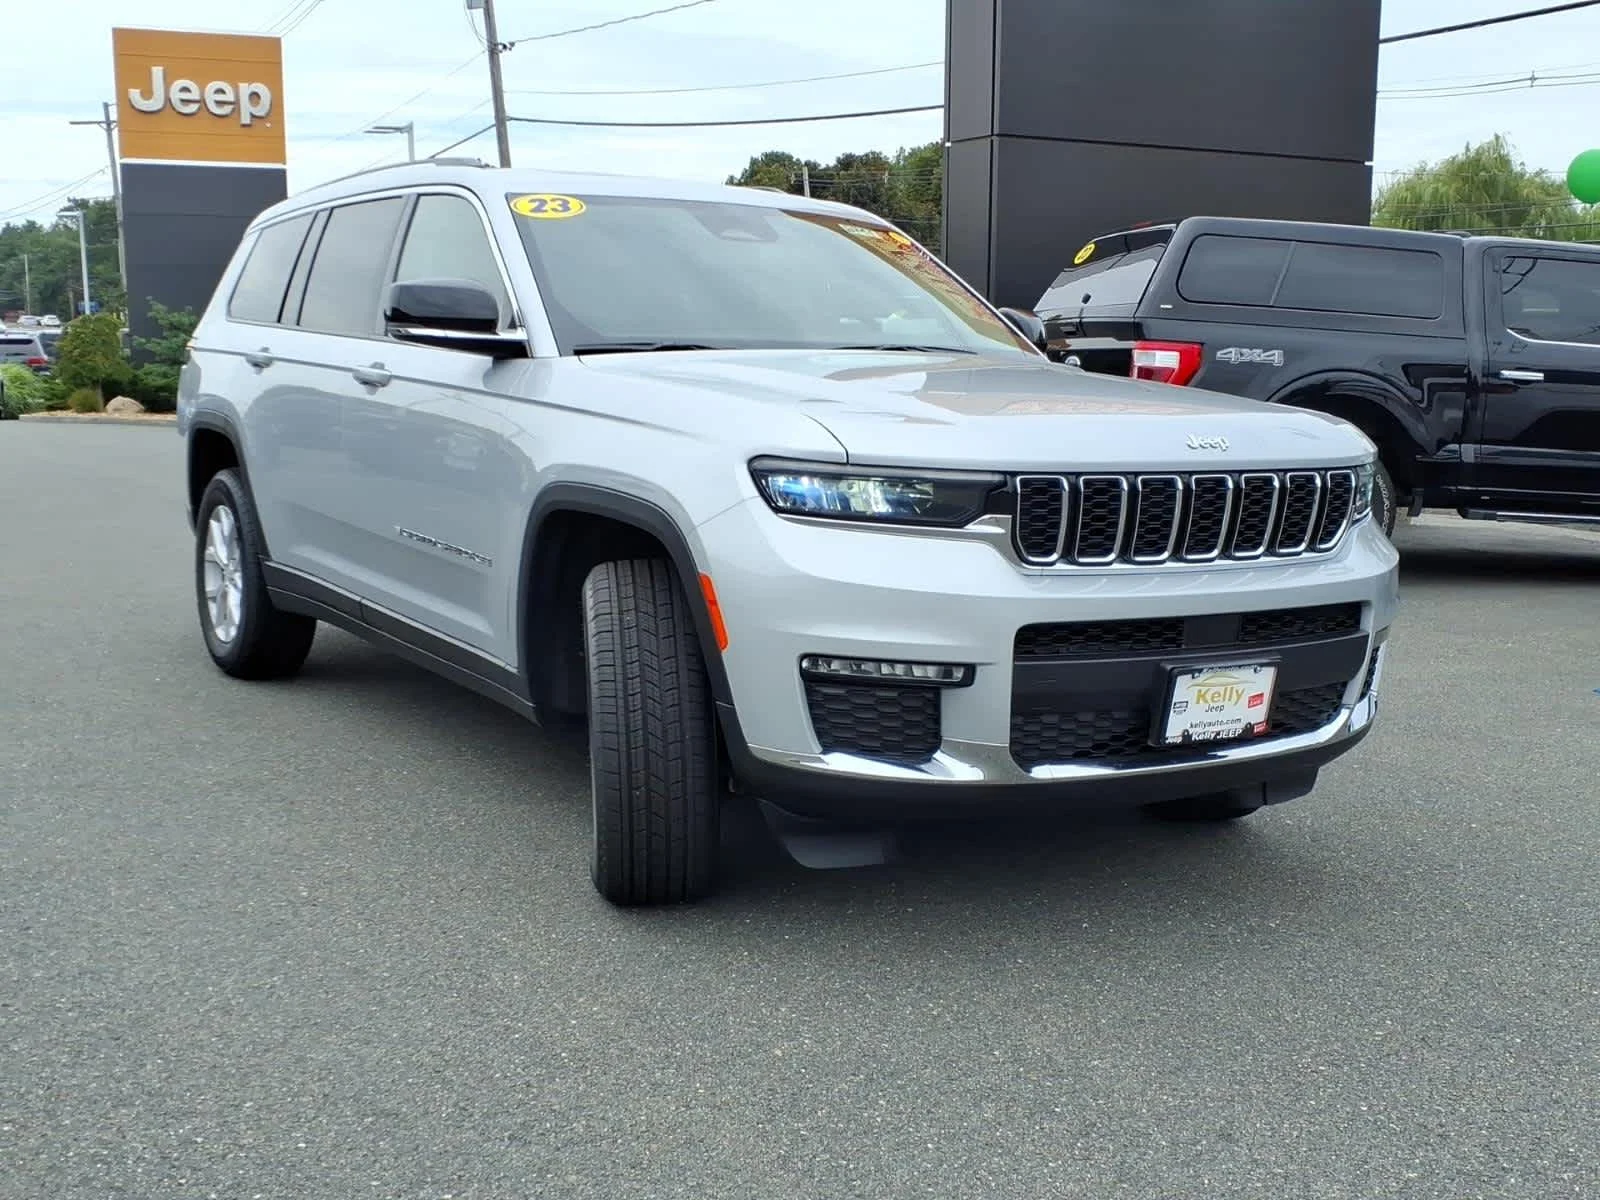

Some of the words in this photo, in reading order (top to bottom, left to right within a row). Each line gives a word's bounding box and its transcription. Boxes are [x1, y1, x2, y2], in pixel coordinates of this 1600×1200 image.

[128, 66, 272, 126] Jeep
[527, 198, 572, 213] 23
[1185, 434, 1230, 452] Jeep
[1195, 686, 1246, 706] Kelly
[1205, 704, 1225, 713] Jeep
[1189, 718, 1242, 729] kellyauto.com
